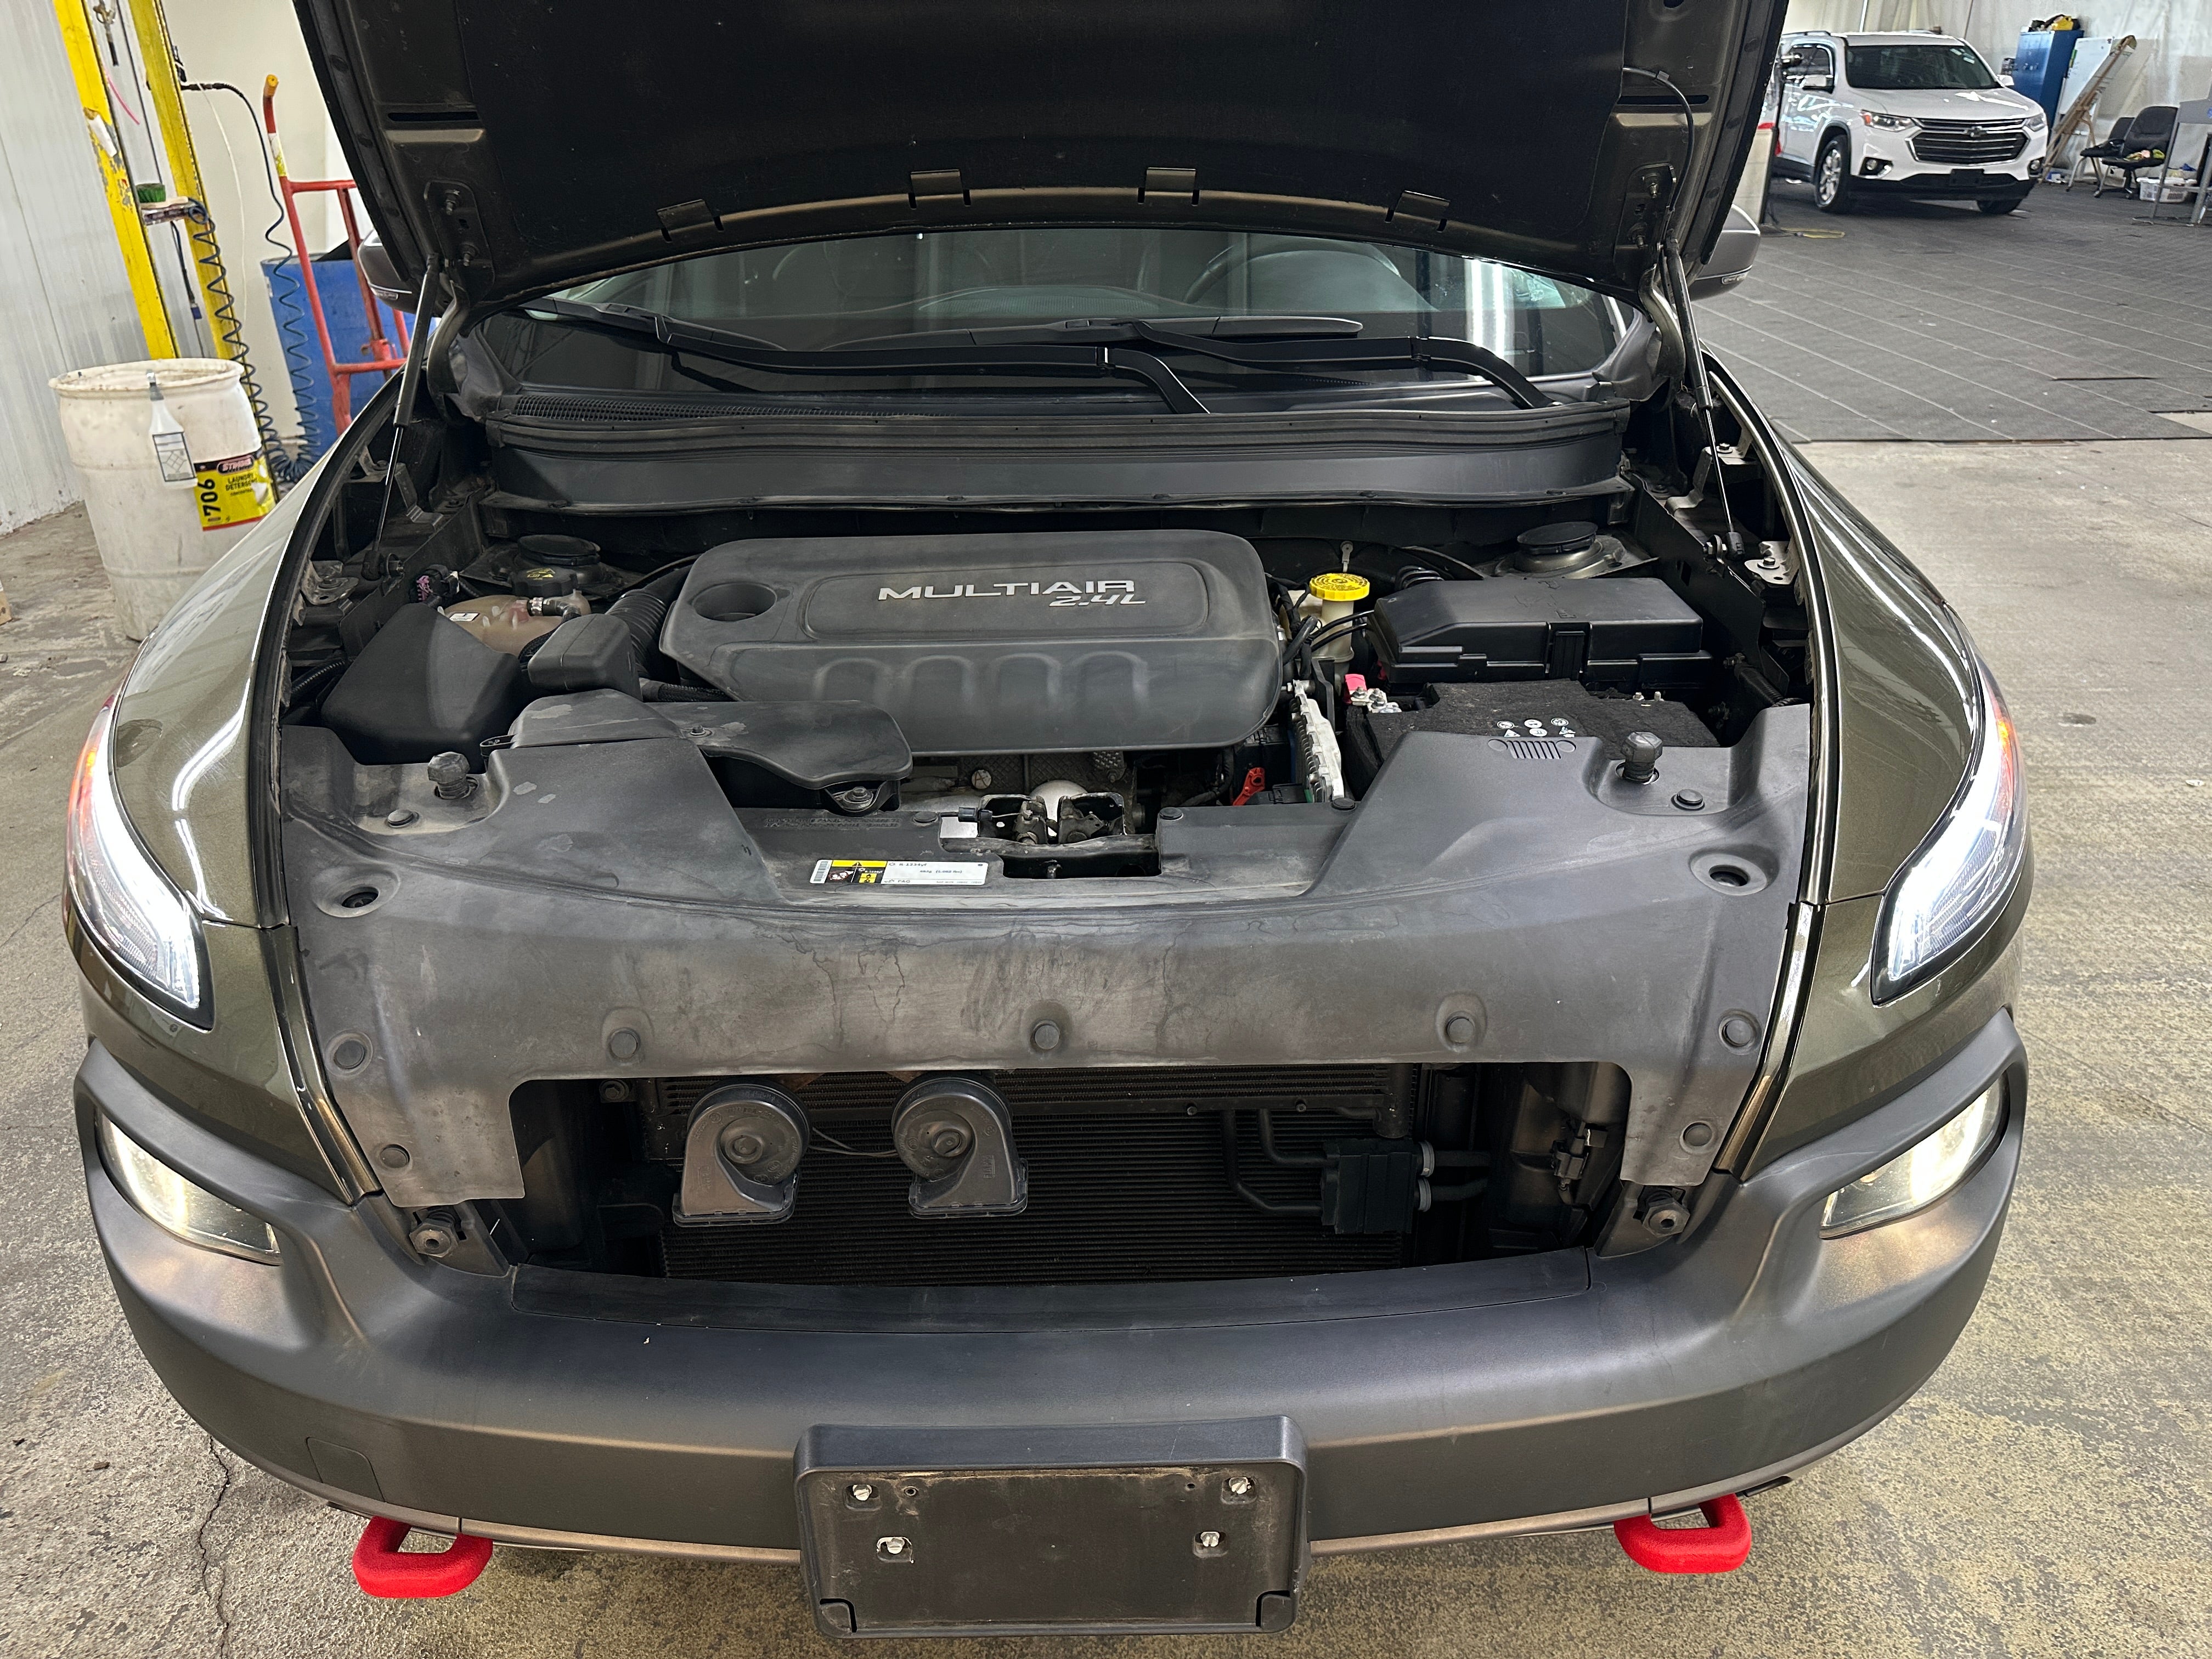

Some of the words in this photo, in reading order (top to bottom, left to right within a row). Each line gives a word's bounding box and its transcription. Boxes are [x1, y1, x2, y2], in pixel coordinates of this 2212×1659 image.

[198, 478, 221, 517] 706
[878, 580, 1135, 601] MULTIAIR
[1048, 594, 1146, 607] 2.4L
